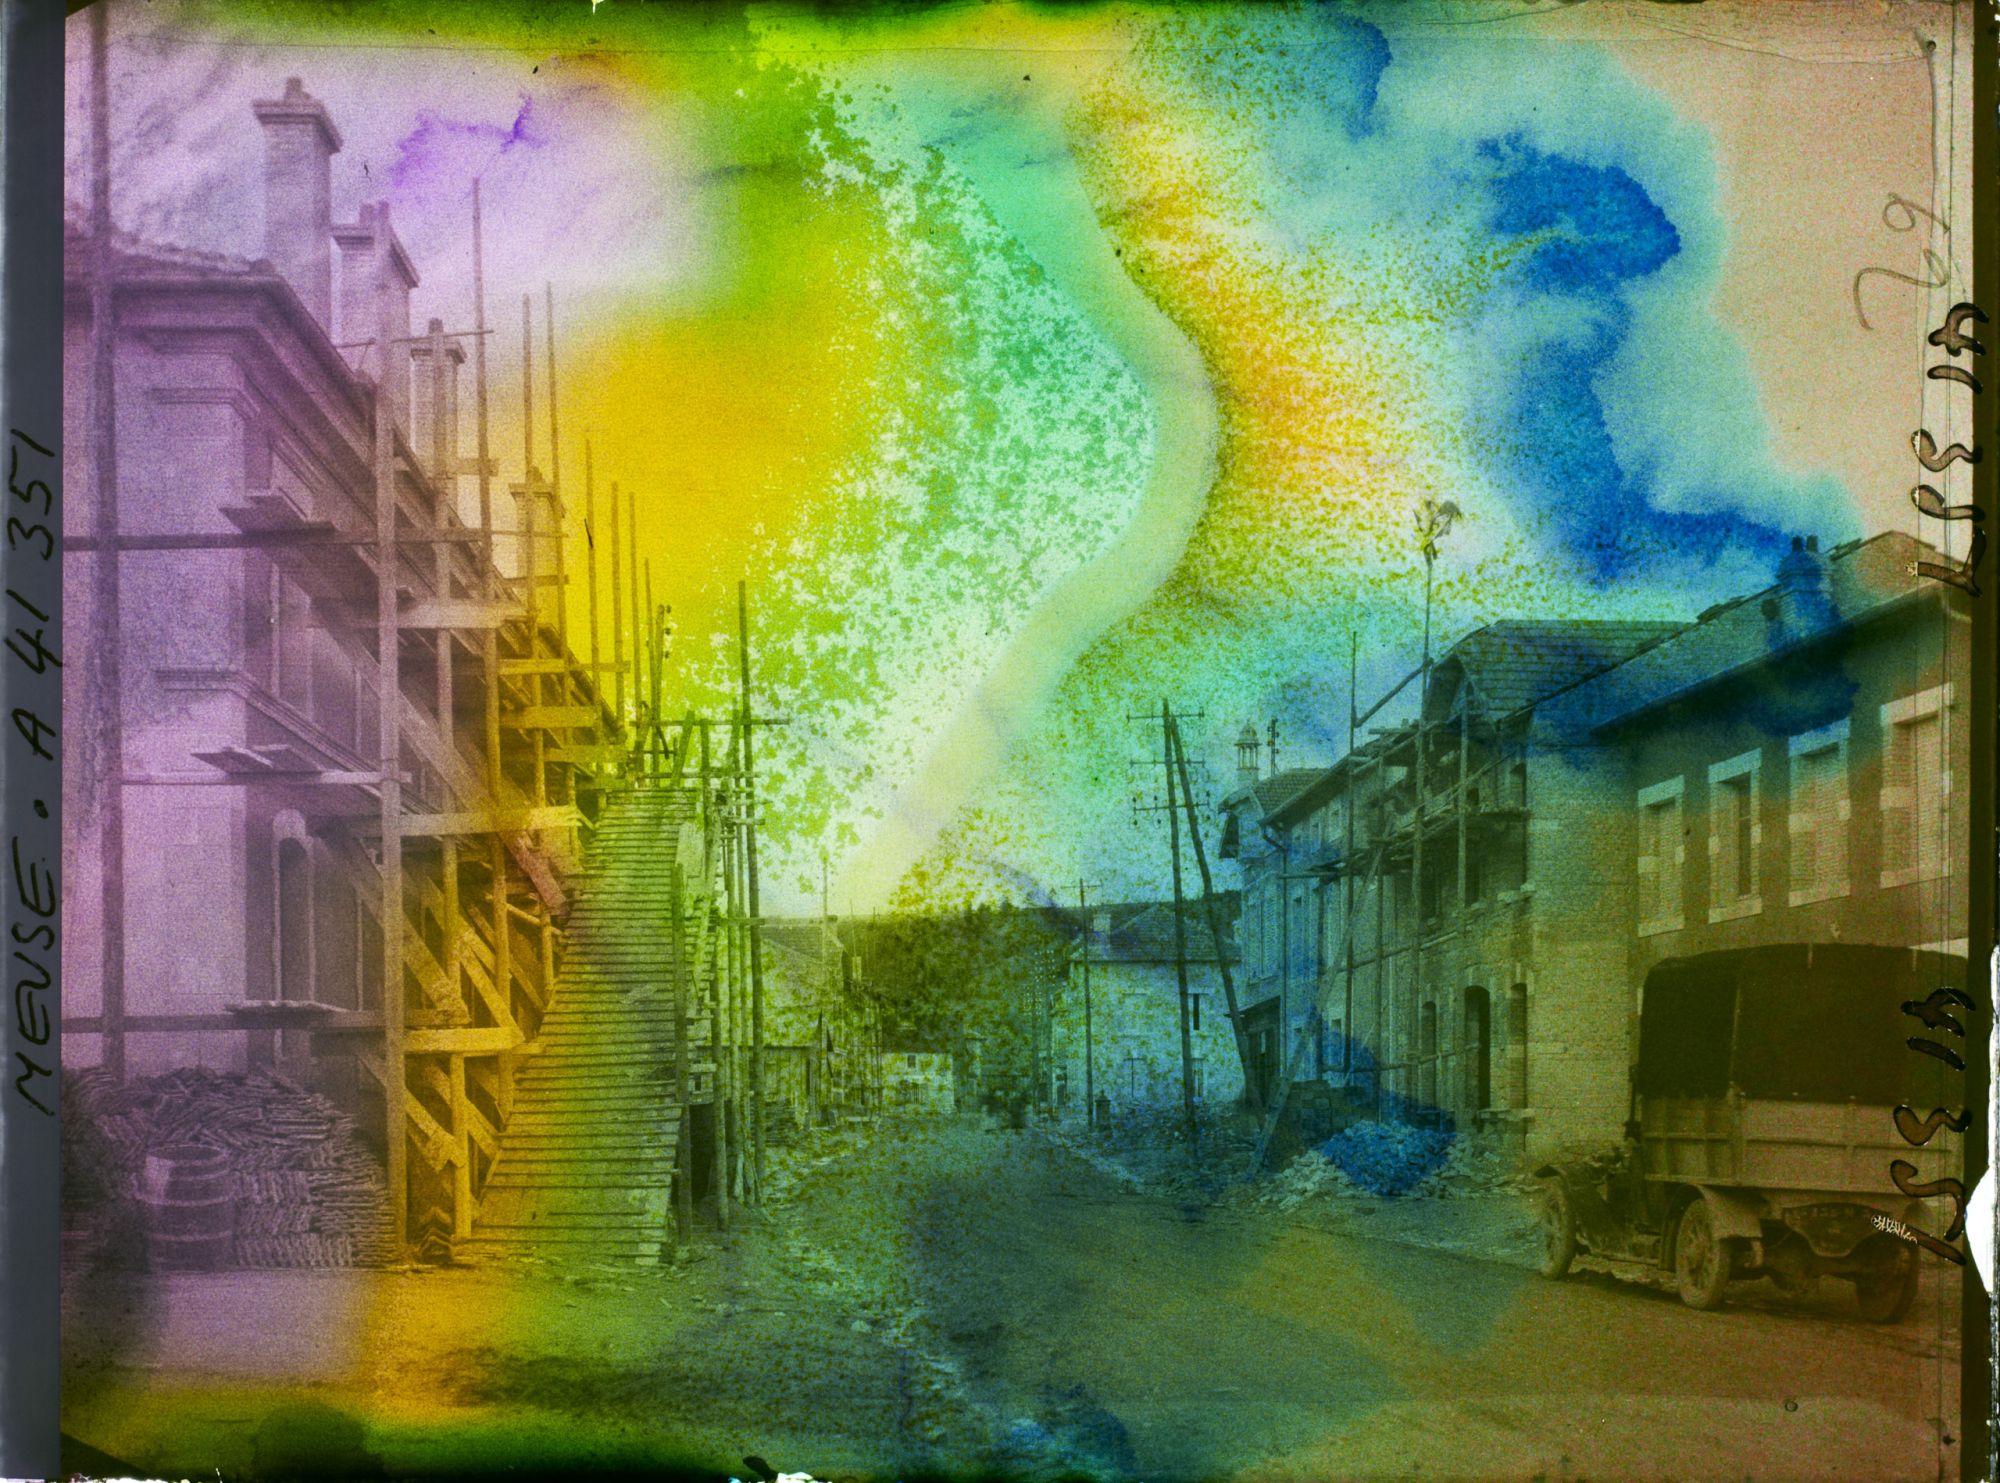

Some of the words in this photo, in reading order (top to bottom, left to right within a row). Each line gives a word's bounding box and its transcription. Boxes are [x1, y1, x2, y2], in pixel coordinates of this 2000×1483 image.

[7, 429, 55, 560] 351
[4, 589, 63, 675] 41
[12, 708, 56, 761] A
